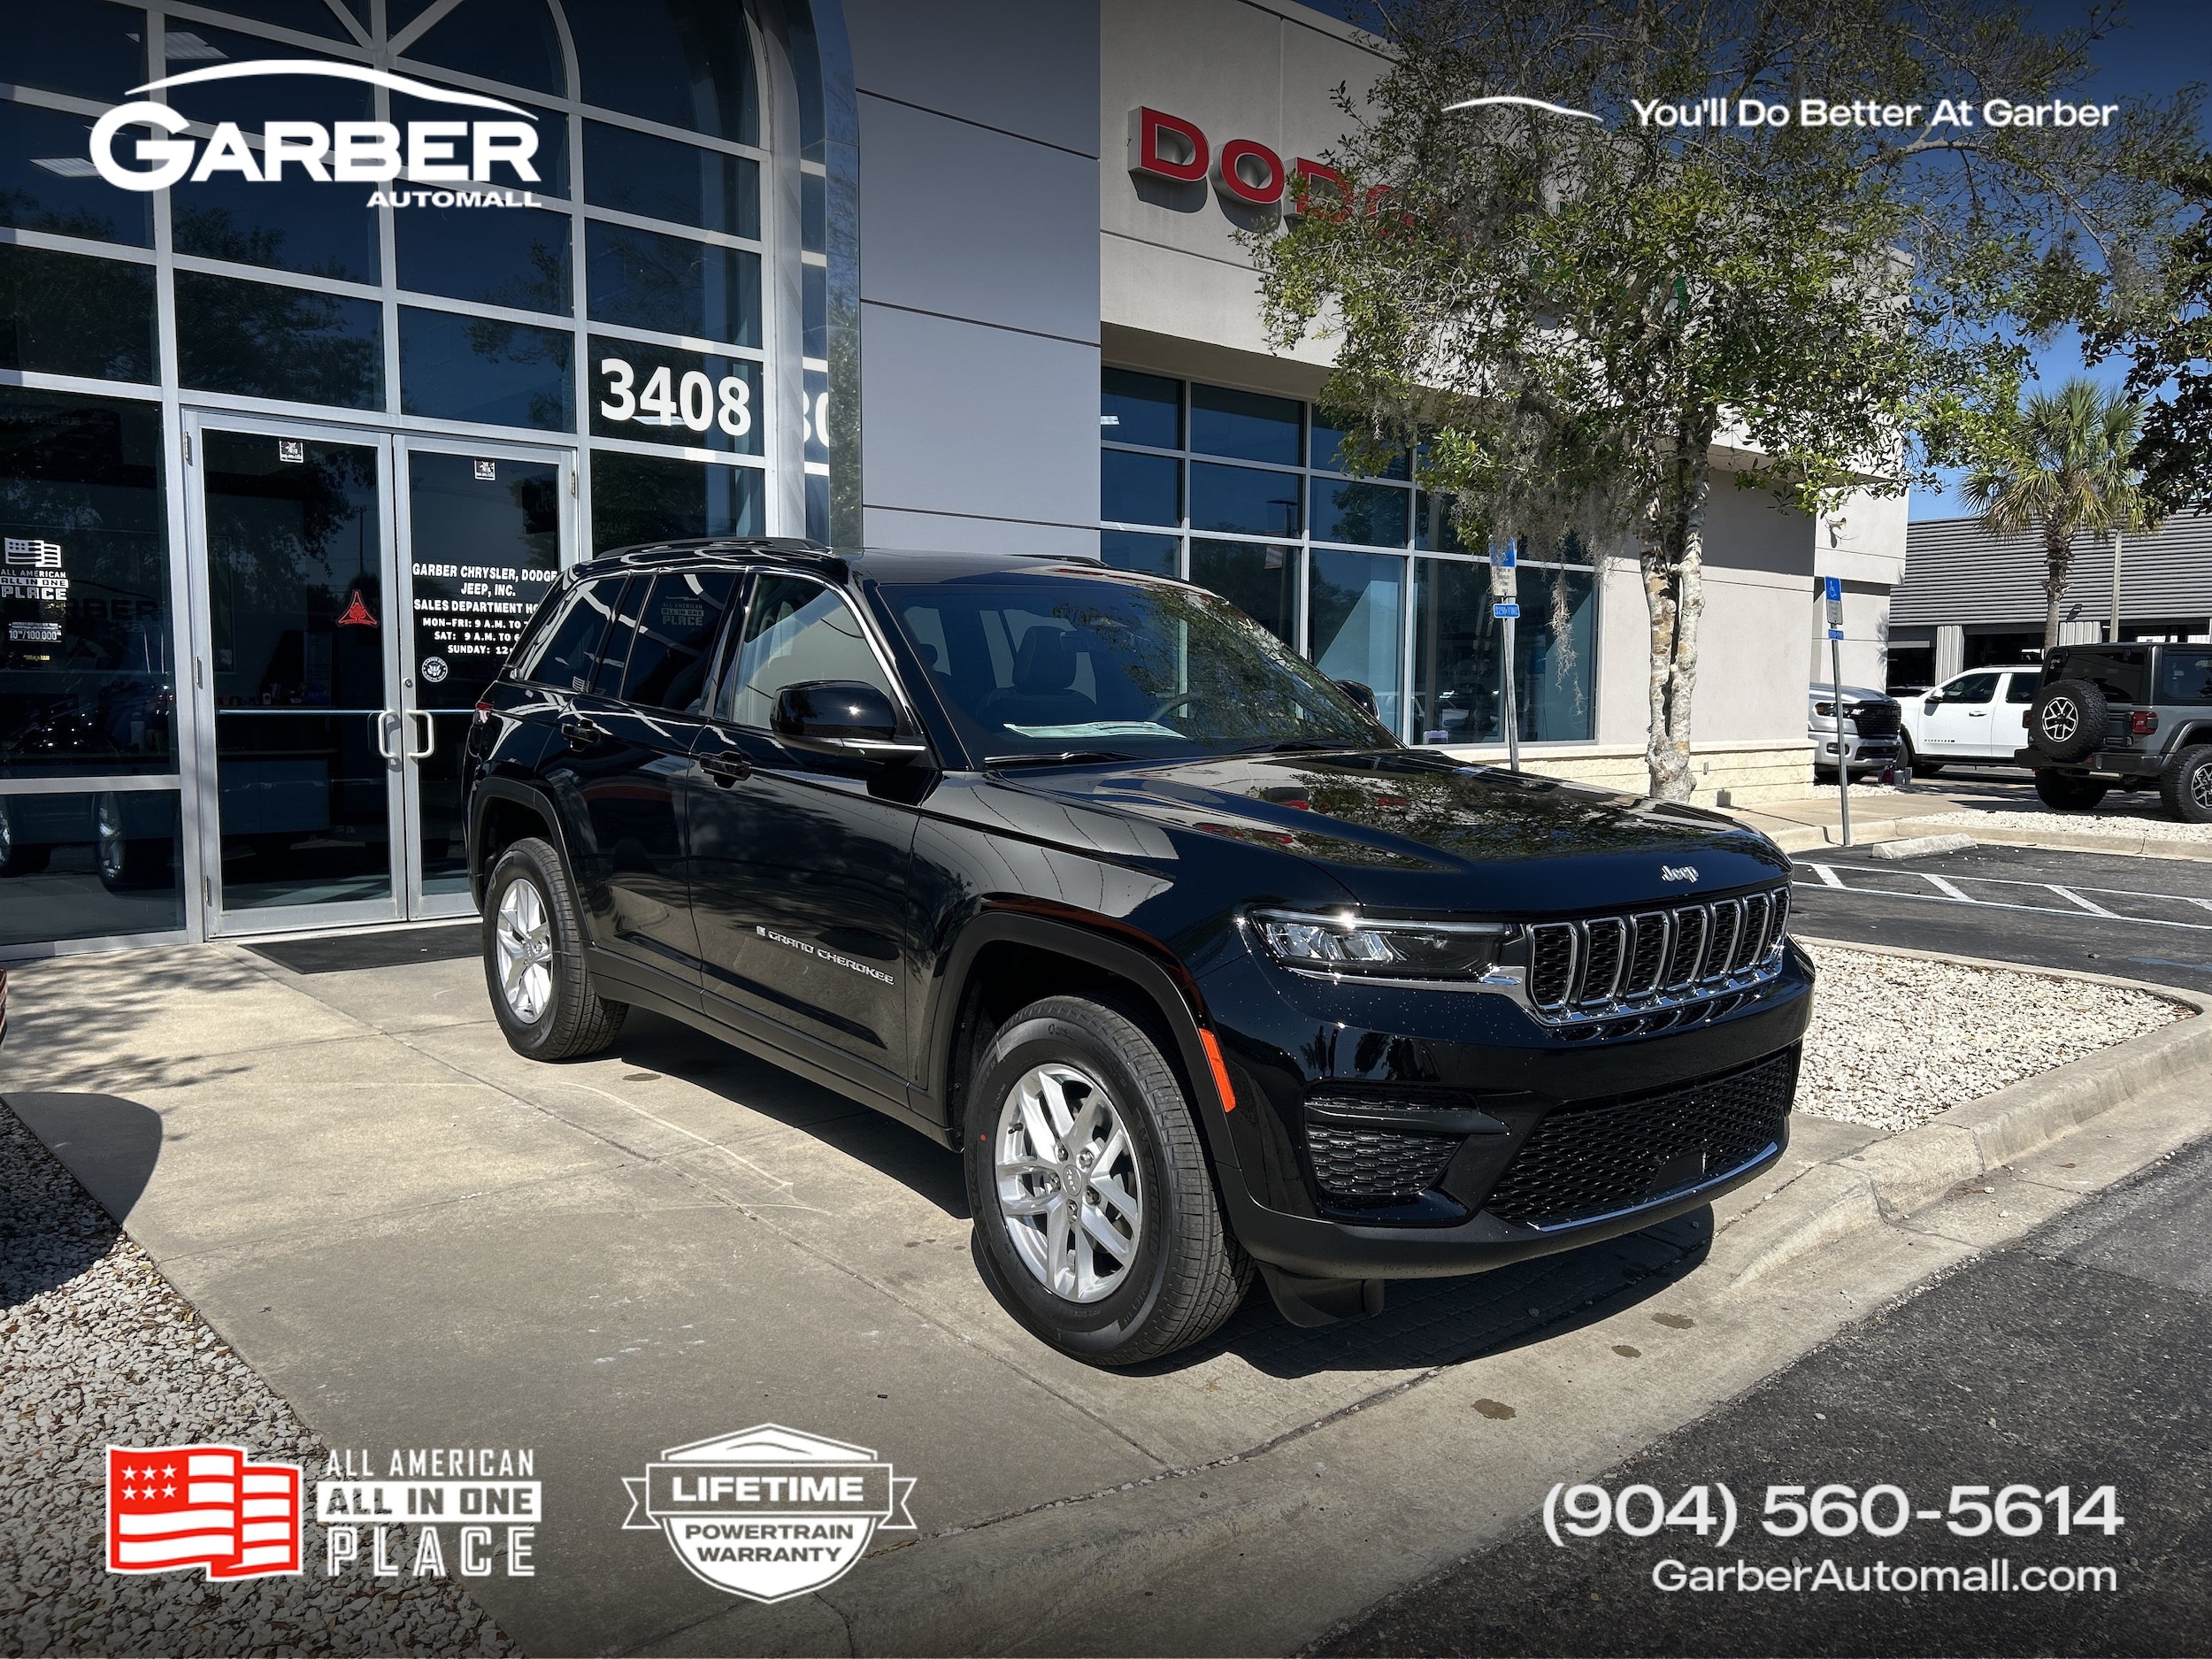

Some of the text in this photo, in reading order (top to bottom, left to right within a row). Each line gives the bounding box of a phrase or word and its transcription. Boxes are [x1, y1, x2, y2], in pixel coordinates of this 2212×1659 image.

[601, 357, 751, 436] 3408
[412, 563, 457, 577] GARBER
[460, 565, 519, 582] CHRYSLER,
[1, 586, 67, 600] PLACE
[461, 583, 516, 597] JEEP, INC.
[414, 599, 449, 611] SALES
[452, 600, 523, 614] DEPARTMENT
[423, 618, 472, 628] MON-FRI:
[474, 619, 481, 628] 9
[484, 619, 506, 629] A.M.
[662, 615, 703, 626] PLACE
[434, 632, 457, 641] SAT:
[473, 633, 495, 641] A.M.
[448, 645, 490, 654] SUNDAY:
[1662, 865, 1700, 883] Jeep
[768, 930, 895, 986] GRAND CHEROKEE
